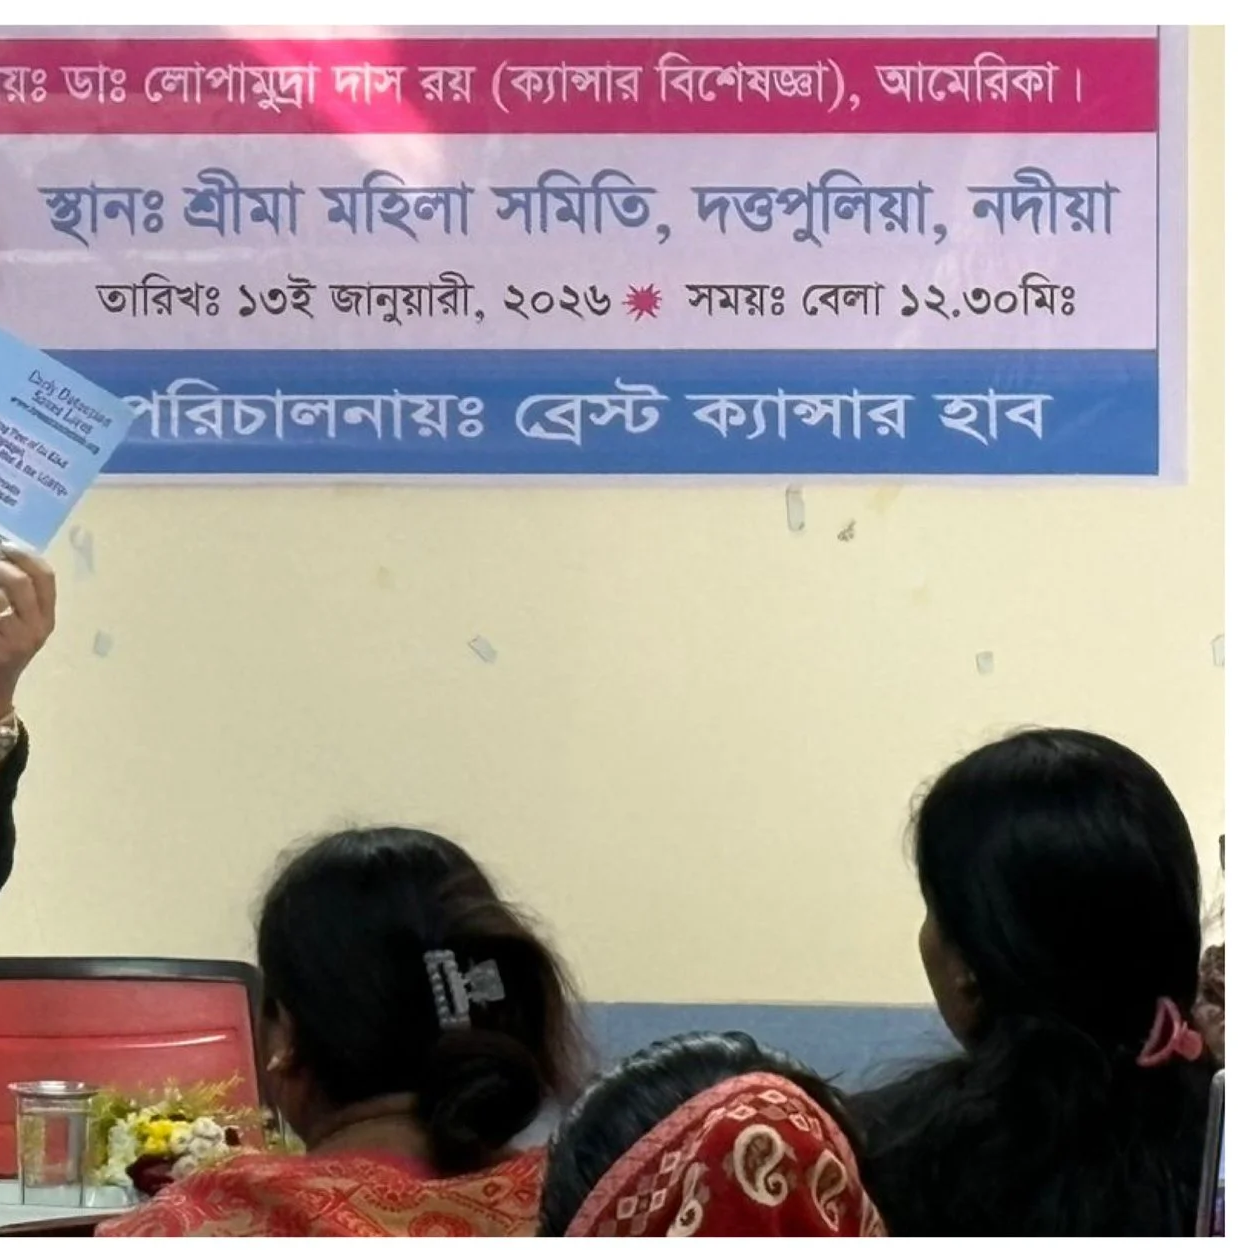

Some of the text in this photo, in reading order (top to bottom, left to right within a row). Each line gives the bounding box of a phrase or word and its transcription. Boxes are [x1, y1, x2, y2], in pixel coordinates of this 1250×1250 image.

[61, 63, 126, 104] ডাঃ
[145, 61, 321, 113] লোপামুদ্রা
[331, 62, 407, 105] দাস
[419, 65, 476, 104] রয়
[492, 60, 643, 114] (ক্যান্সার
[654, 51, 861, 113] বিশেষজ্ঞা),
[876, 51, 1060, 104] আমেরিকা
[38, 166, 1123, 247] স্থানঃ শ্রীমা মহিলা সমিতি, দত্তপুলিয়া, নদীয়া
[96, 271, 1075, 325] তারিখঃ ১৩ই জানুয়ারী, ২০২৬ সময়ঃ বেলা ১২.৩০মিঃ
[121, 377, 484, 441] পরিচালনায়ঃ
[516, 377, 670, 447] ব্রেস্ট
[685, 387, 916, 441] ক্যান্সার
[933, 388, 1054, 447] হাব
